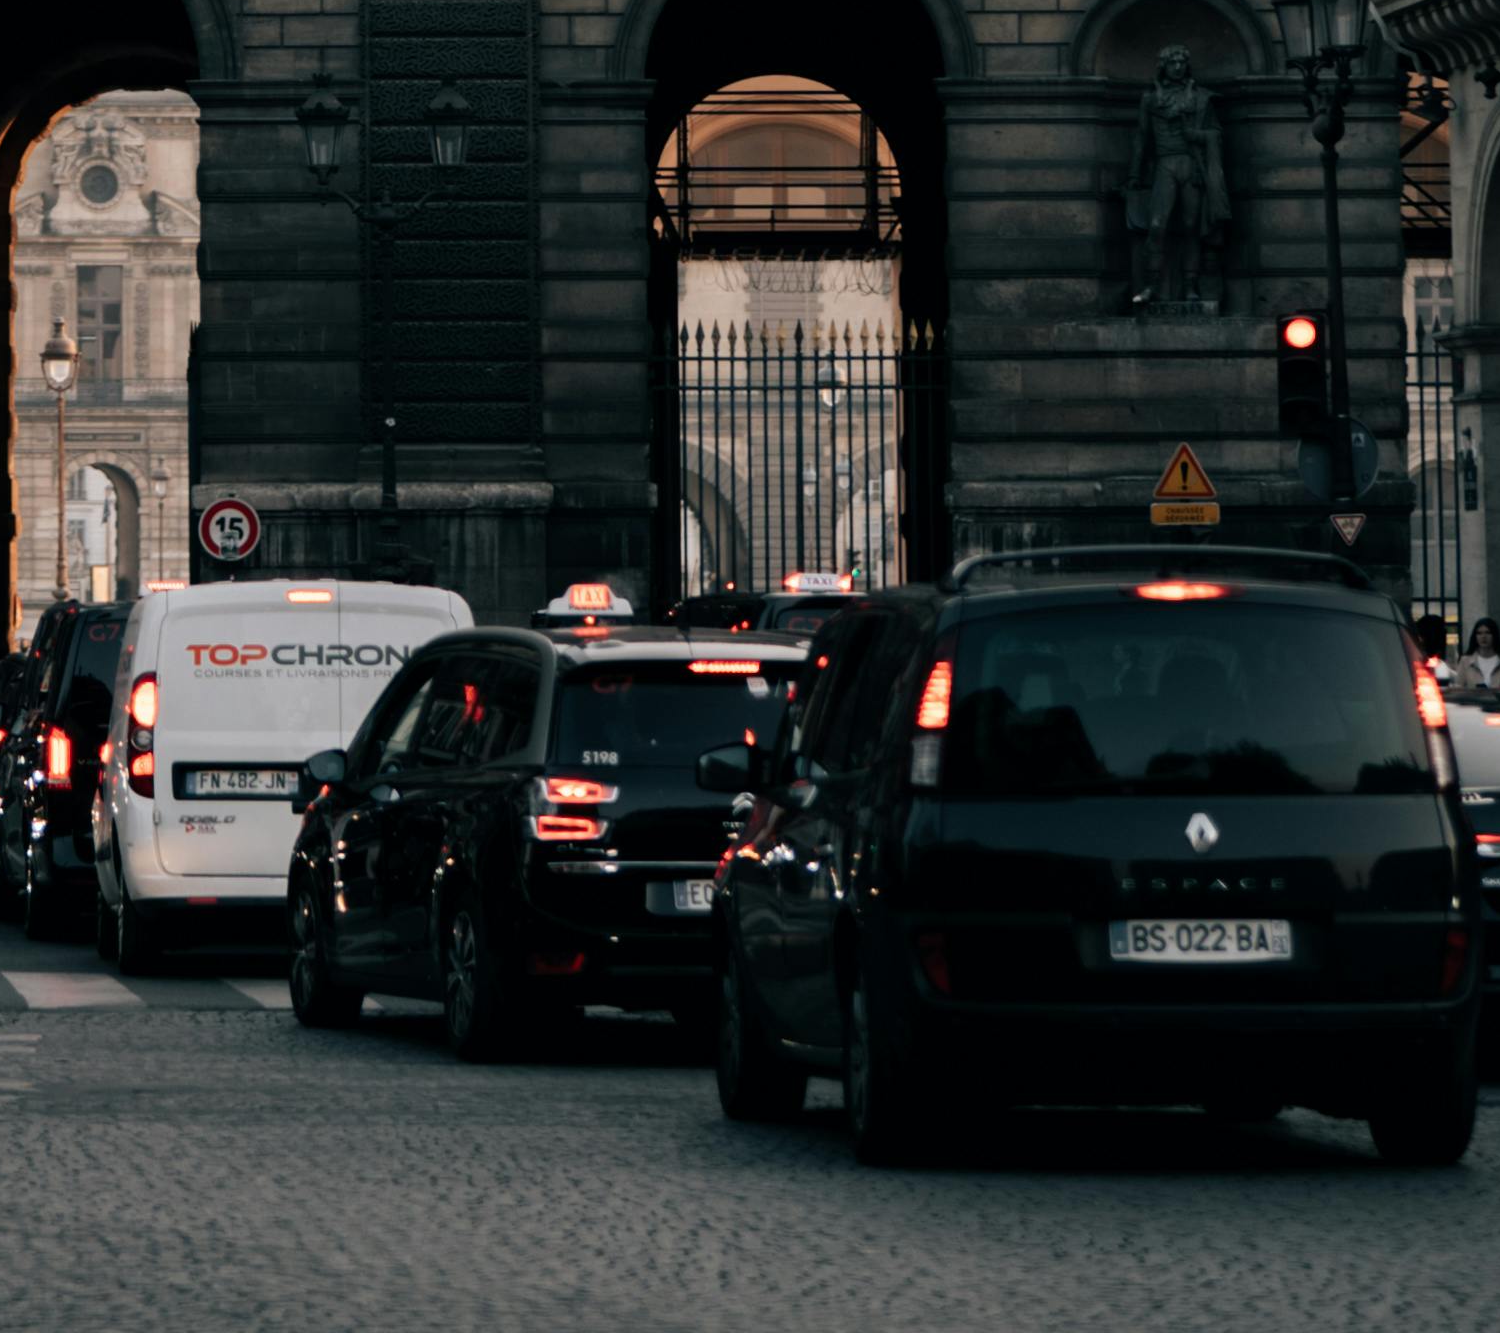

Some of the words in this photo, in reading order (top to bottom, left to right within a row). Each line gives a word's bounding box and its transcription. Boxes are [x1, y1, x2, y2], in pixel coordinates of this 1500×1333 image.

[215, 516, 244, 541] 15
[806, 577, 833, 585] TAXI
[87, 622, 121, 643] G7
[185, 644, 416, 667] TOPCHRON
[193, 668, 263, 678] COURSES
[266, 668, 283, 678] ET
[286, 668, 370, 678] LIVRAISONS
[581, 750, 620, 766] 5198
[1121, 877, 1287, 890] ESPACE
[1131, 923, 1270, 953] BS-022-BA
